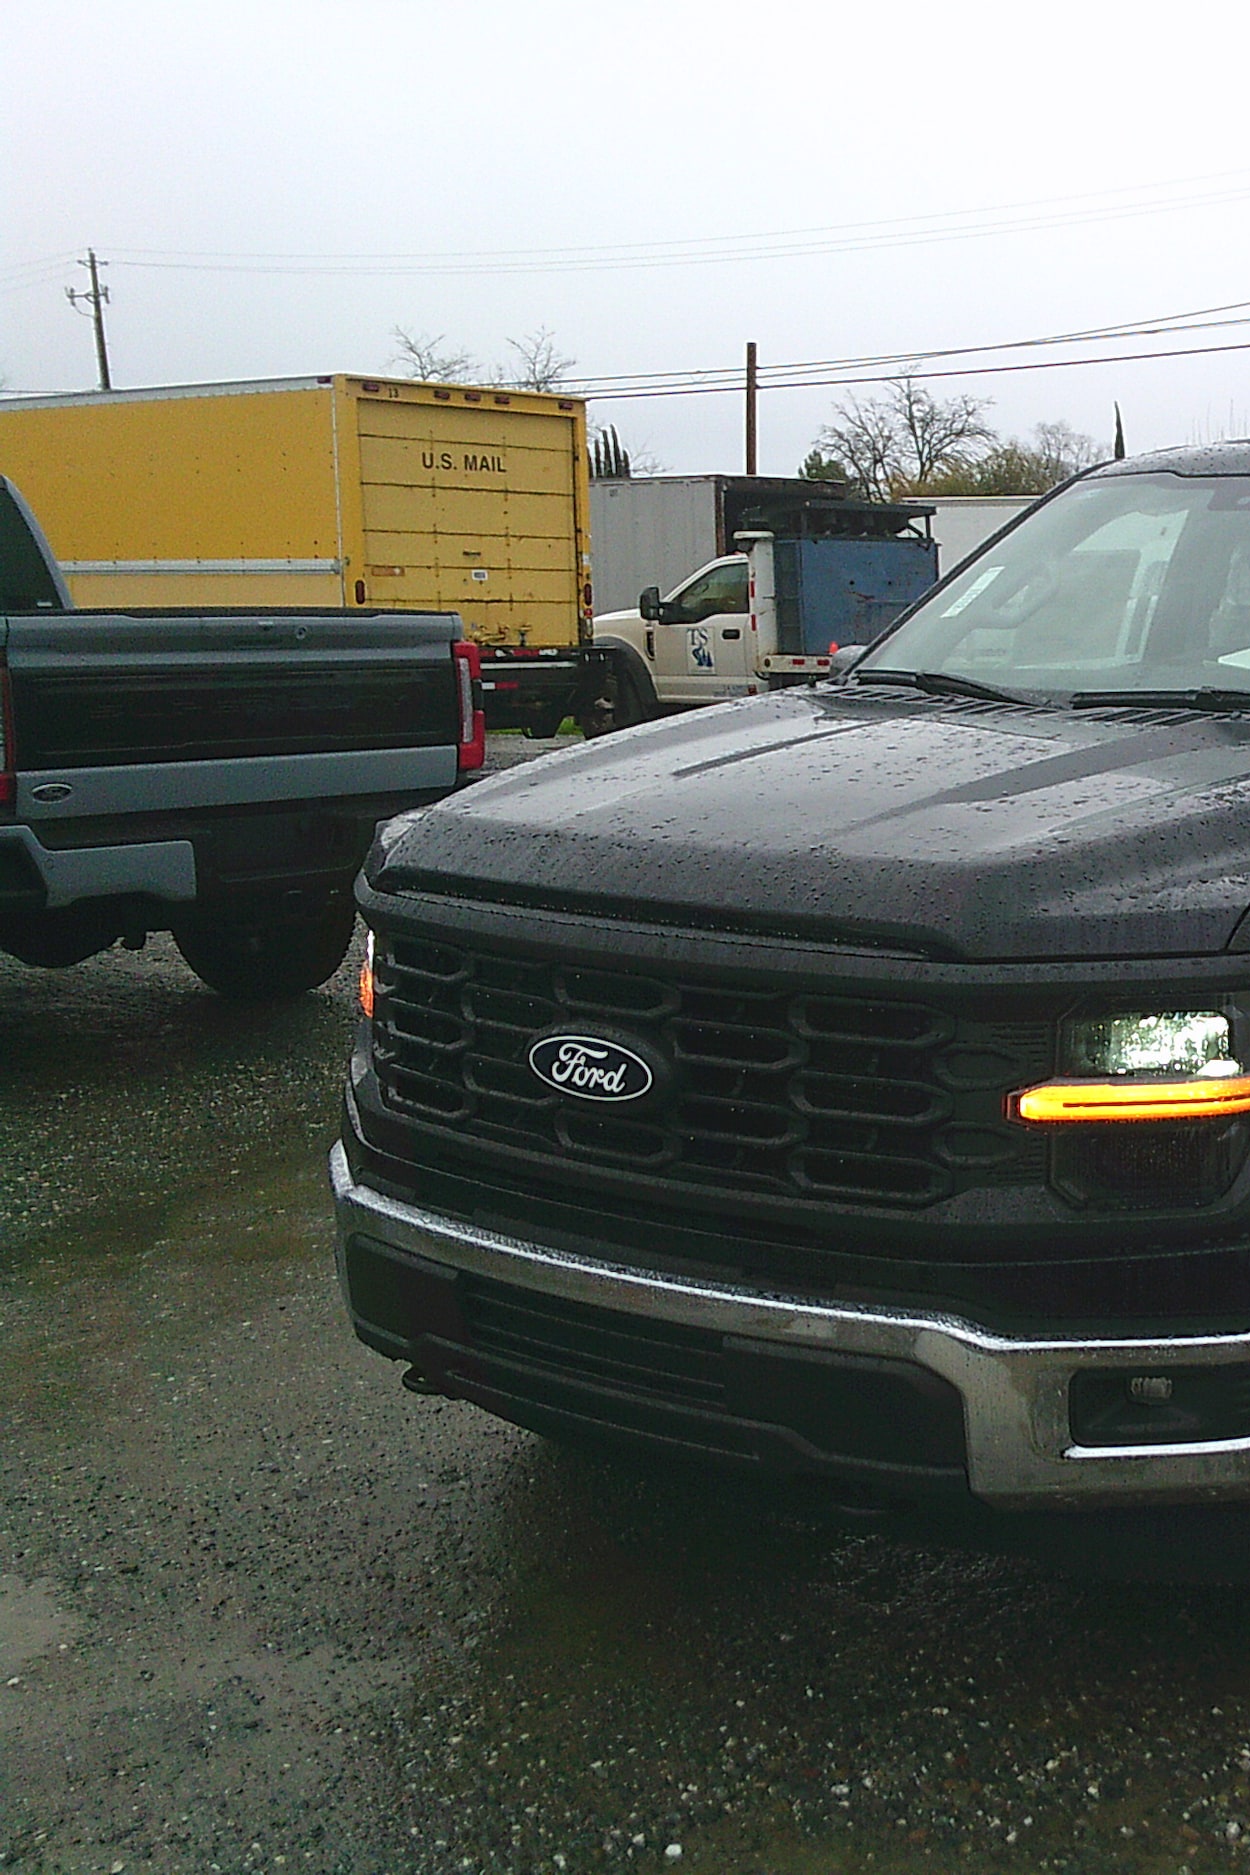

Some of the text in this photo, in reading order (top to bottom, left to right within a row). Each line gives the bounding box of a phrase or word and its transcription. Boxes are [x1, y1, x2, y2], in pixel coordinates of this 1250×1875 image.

[422, 452, 507, 473] U.S. MAIL
[551, 1042, 627, 1093] Ford
